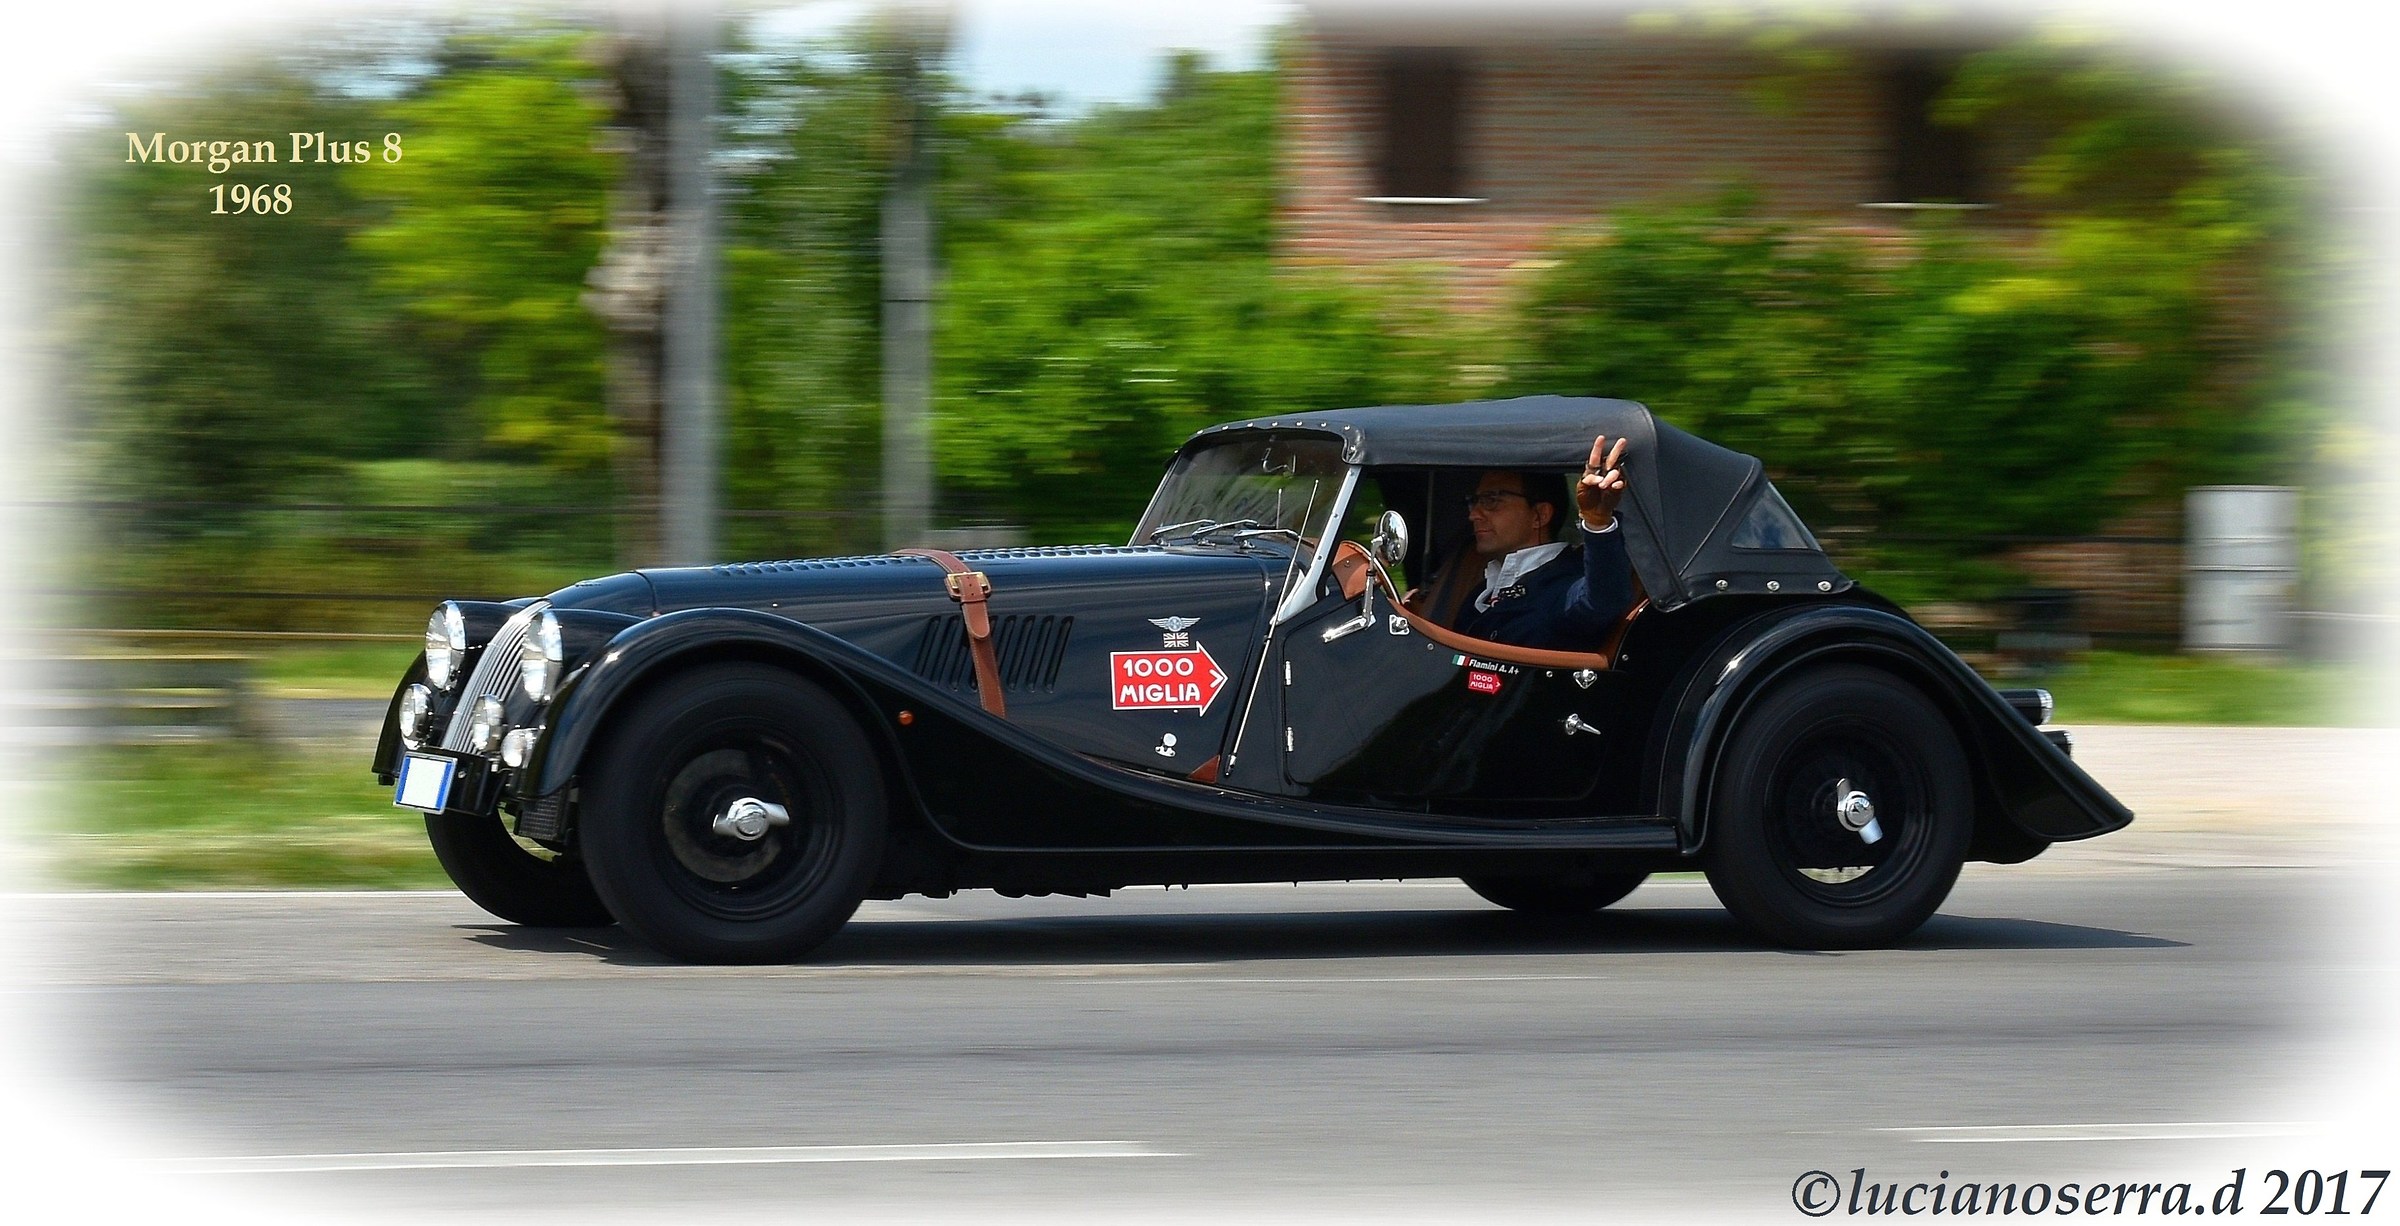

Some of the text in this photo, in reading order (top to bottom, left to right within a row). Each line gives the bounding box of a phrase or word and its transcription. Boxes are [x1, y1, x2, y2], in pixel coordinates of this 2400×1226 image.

[1122, 657, 1194, 677] 1000
[1469, 659, 1498, 671] Flamini
[1473, 674, 1493, 682] 1000
[1470, 681, 1494, 690] MIGLIA
[1119, 683, 1201, 704] MIGLIA
